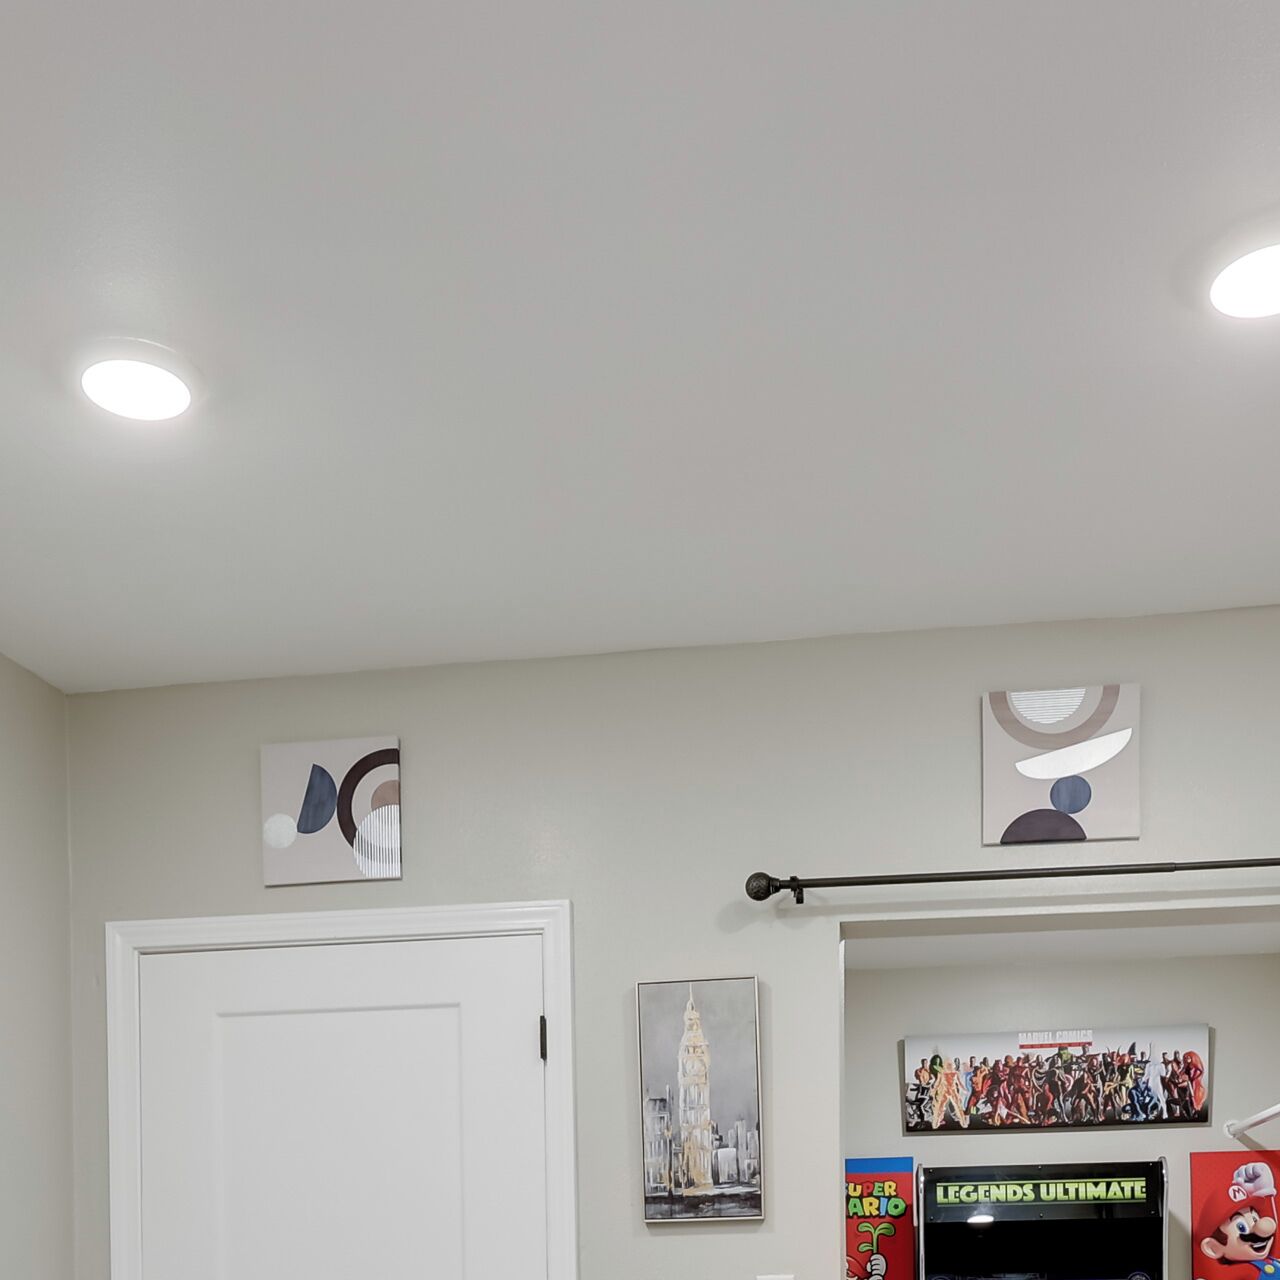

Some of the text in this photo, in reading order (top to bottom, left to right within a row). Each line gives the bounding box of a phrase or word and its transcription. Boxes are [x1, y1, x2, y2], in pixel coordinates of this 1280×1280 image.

[1018, 1030, 1093, 1043] MARVEL COMICS
[845, 1181, 897, 1197] UPER
[935, 1180, 1147, 1204] LEGENDS ULTIMATE
[846, 1197, 907, 1217] ARIO
